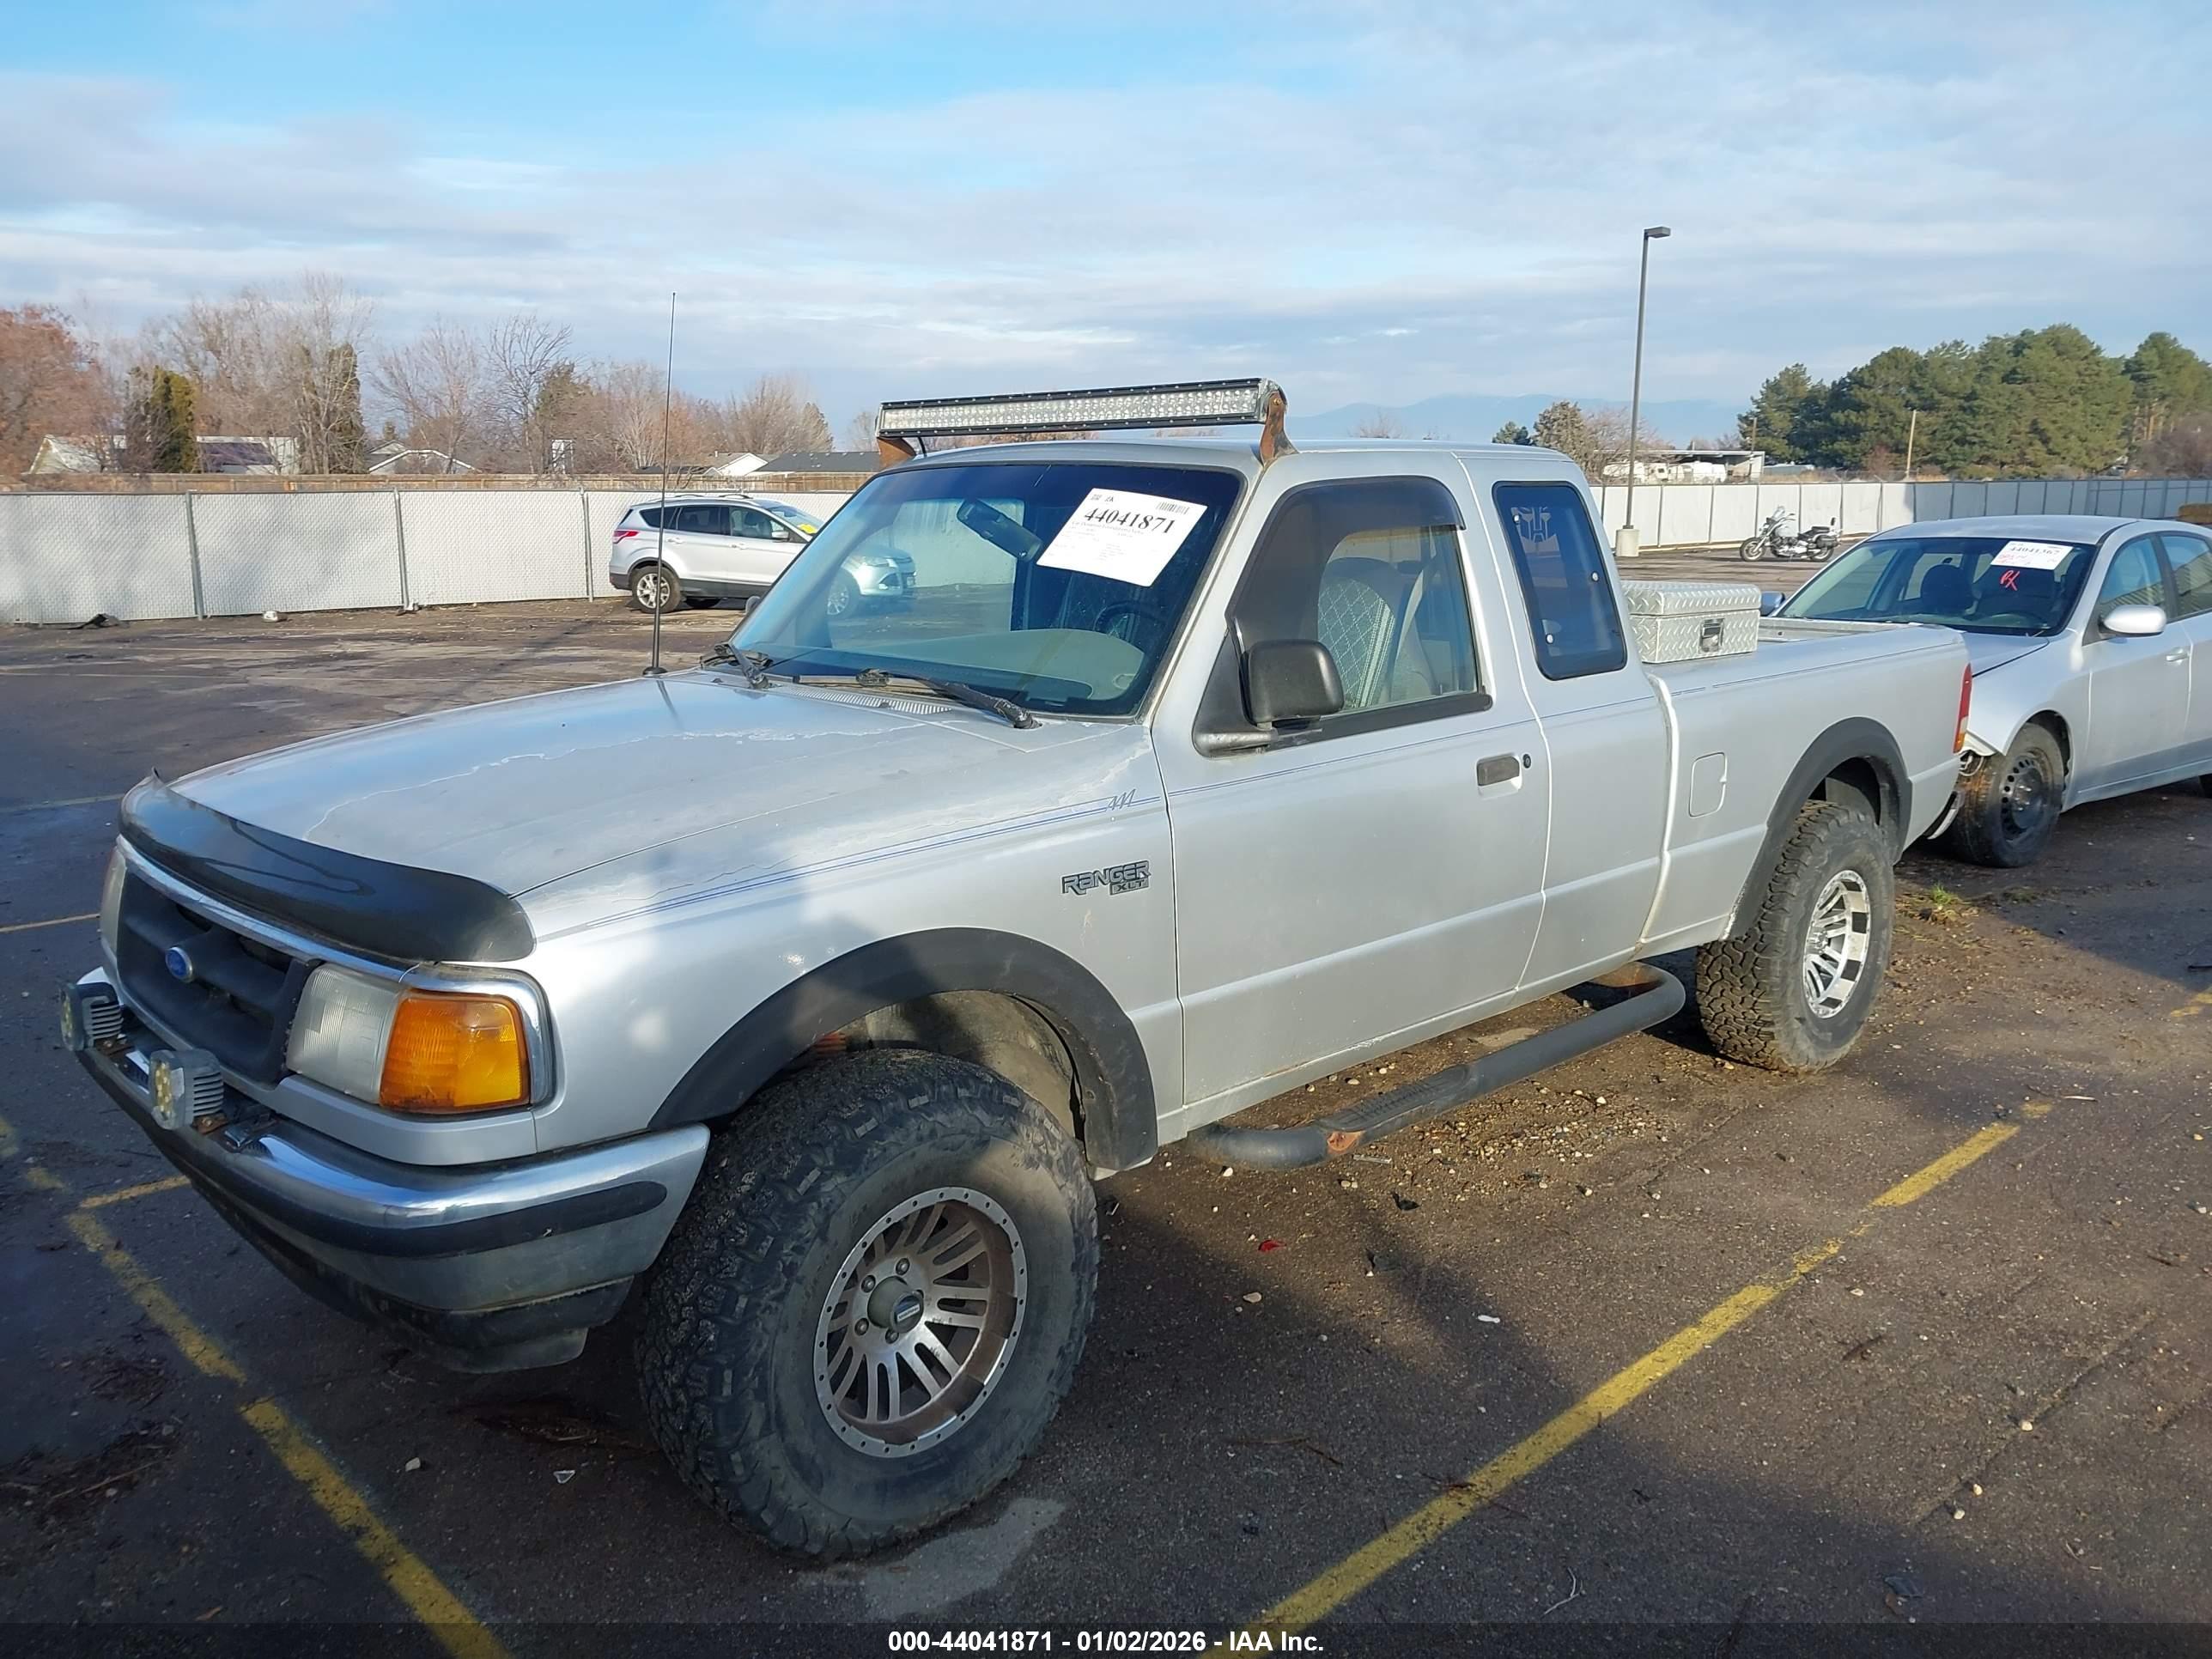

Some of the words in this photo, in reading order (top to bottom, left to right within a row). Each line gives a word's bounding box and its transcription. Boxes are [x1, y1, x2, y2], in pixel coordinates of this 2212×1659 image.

[1084, 507, 1176, 534] 44041871
[1061, 860, 1152, 896] RANGER
[1116, 879, 1146, 892] XLT
